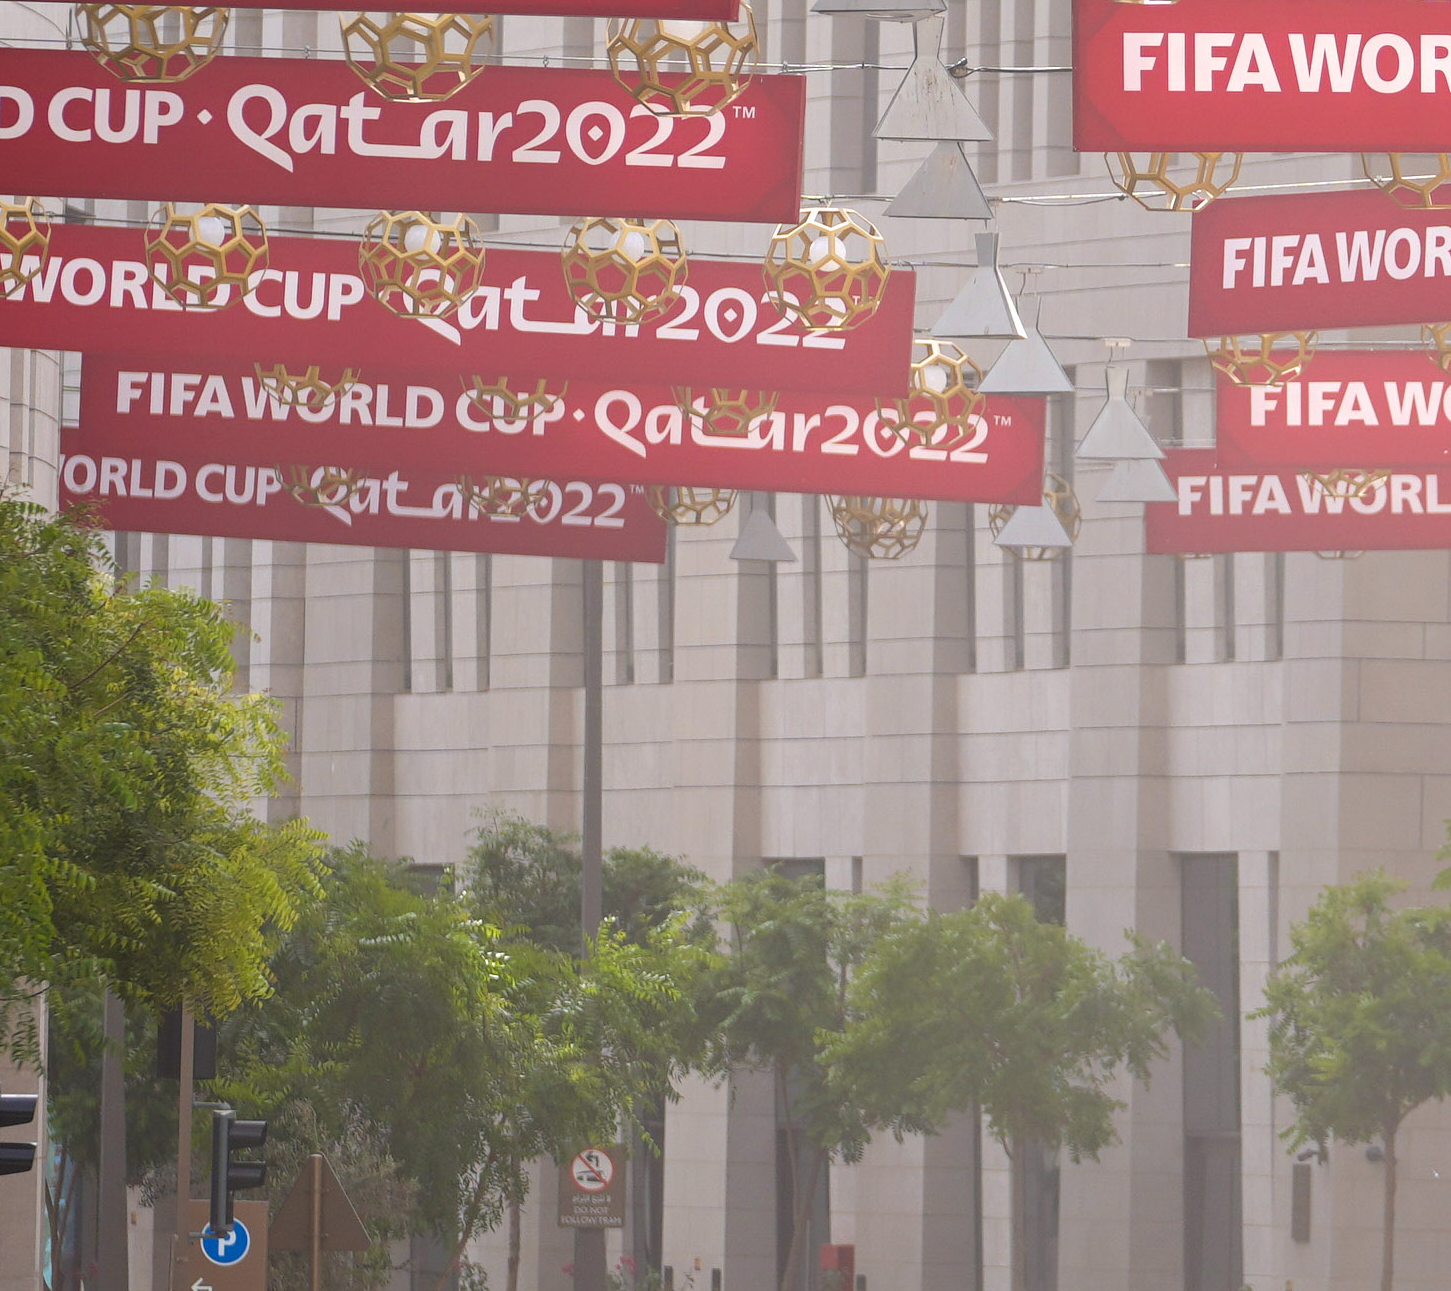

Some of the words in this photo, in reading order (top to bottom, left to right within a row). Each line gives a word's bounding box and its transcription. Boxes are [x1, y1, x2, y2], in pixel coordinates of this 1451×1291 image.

[1123, 32, 1281, 93] FIFA
[47, 87, 189, 144] CUP
[1222, 233, 1330, 289] FIFA
[241, 268, 364, 321] CUP
[116, 371, 235, 418] FIFA
[242, 377, 445, 429] WORLD
[454, 388, 566, 436] CUP
[1249, 381, 1378, 427] FIFA
[59, 454, 188, 500] ORLD
[195, 462, 282, 507] CUP
[1176, 474, 1293, 517] FIFA
